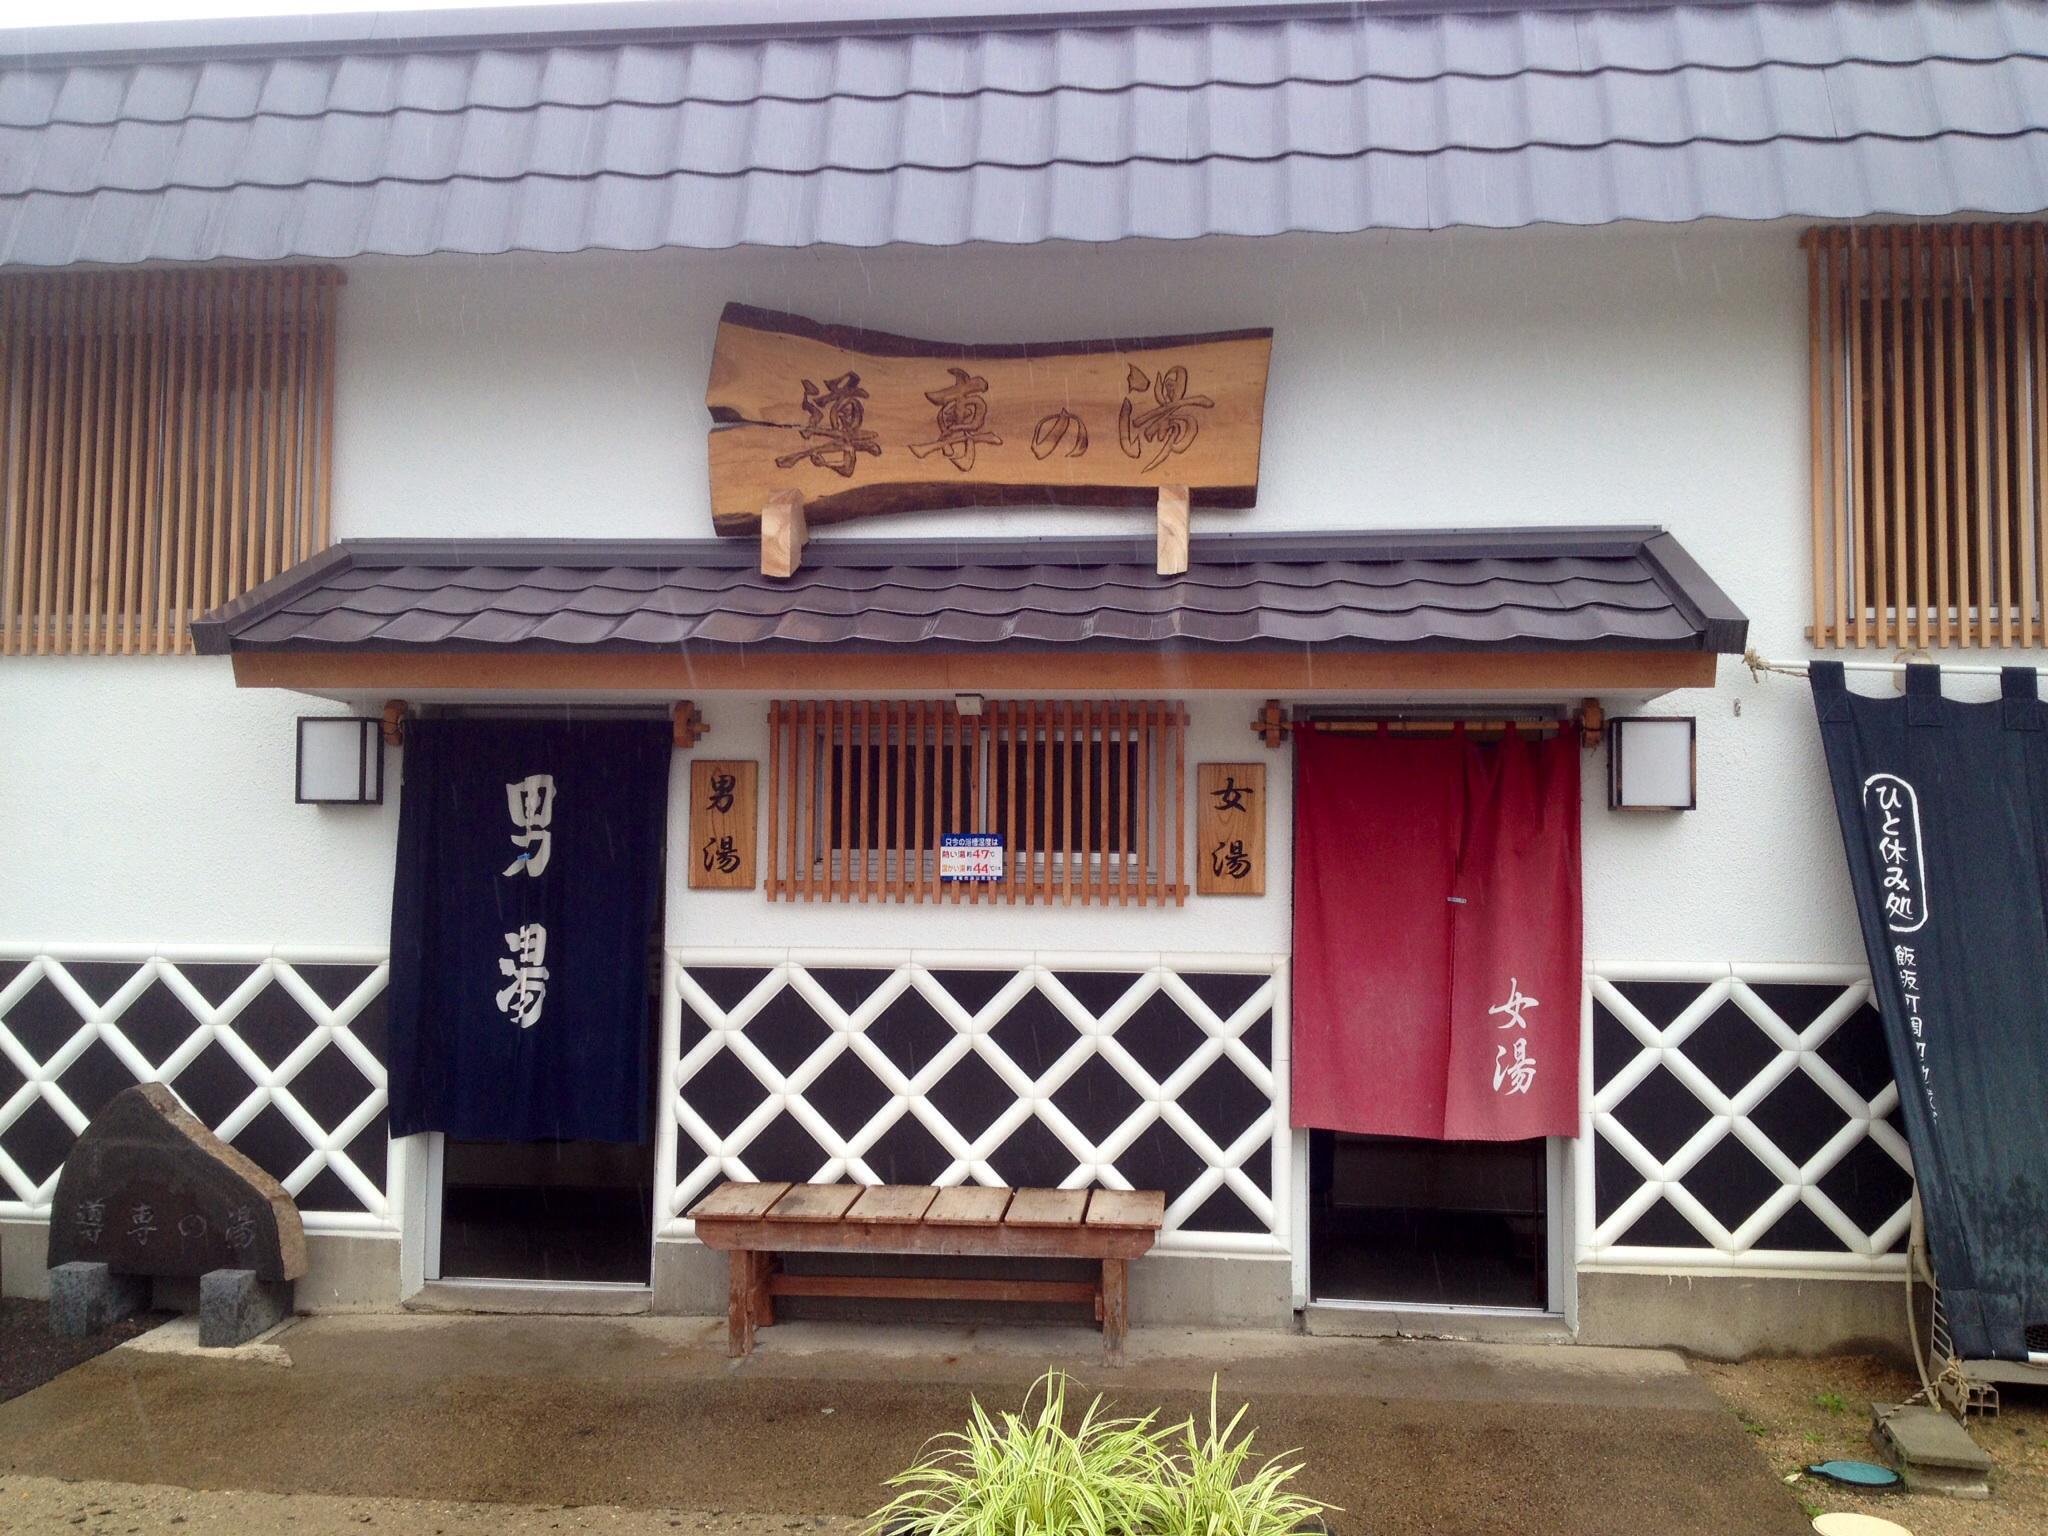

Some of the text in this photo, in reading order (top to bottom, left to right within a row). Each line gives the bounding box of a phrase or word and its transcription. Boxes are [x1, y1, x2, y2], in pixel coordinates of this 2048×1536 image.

[702, 774, 741, 874] 男湯
[1211, 777, 1253, 879] 女湯
[1875, 785, 1914, 921] ひと休み処
[496, 774, 557, 1029] 男湯
[1489, 977, 1540, 1096] 女湯
